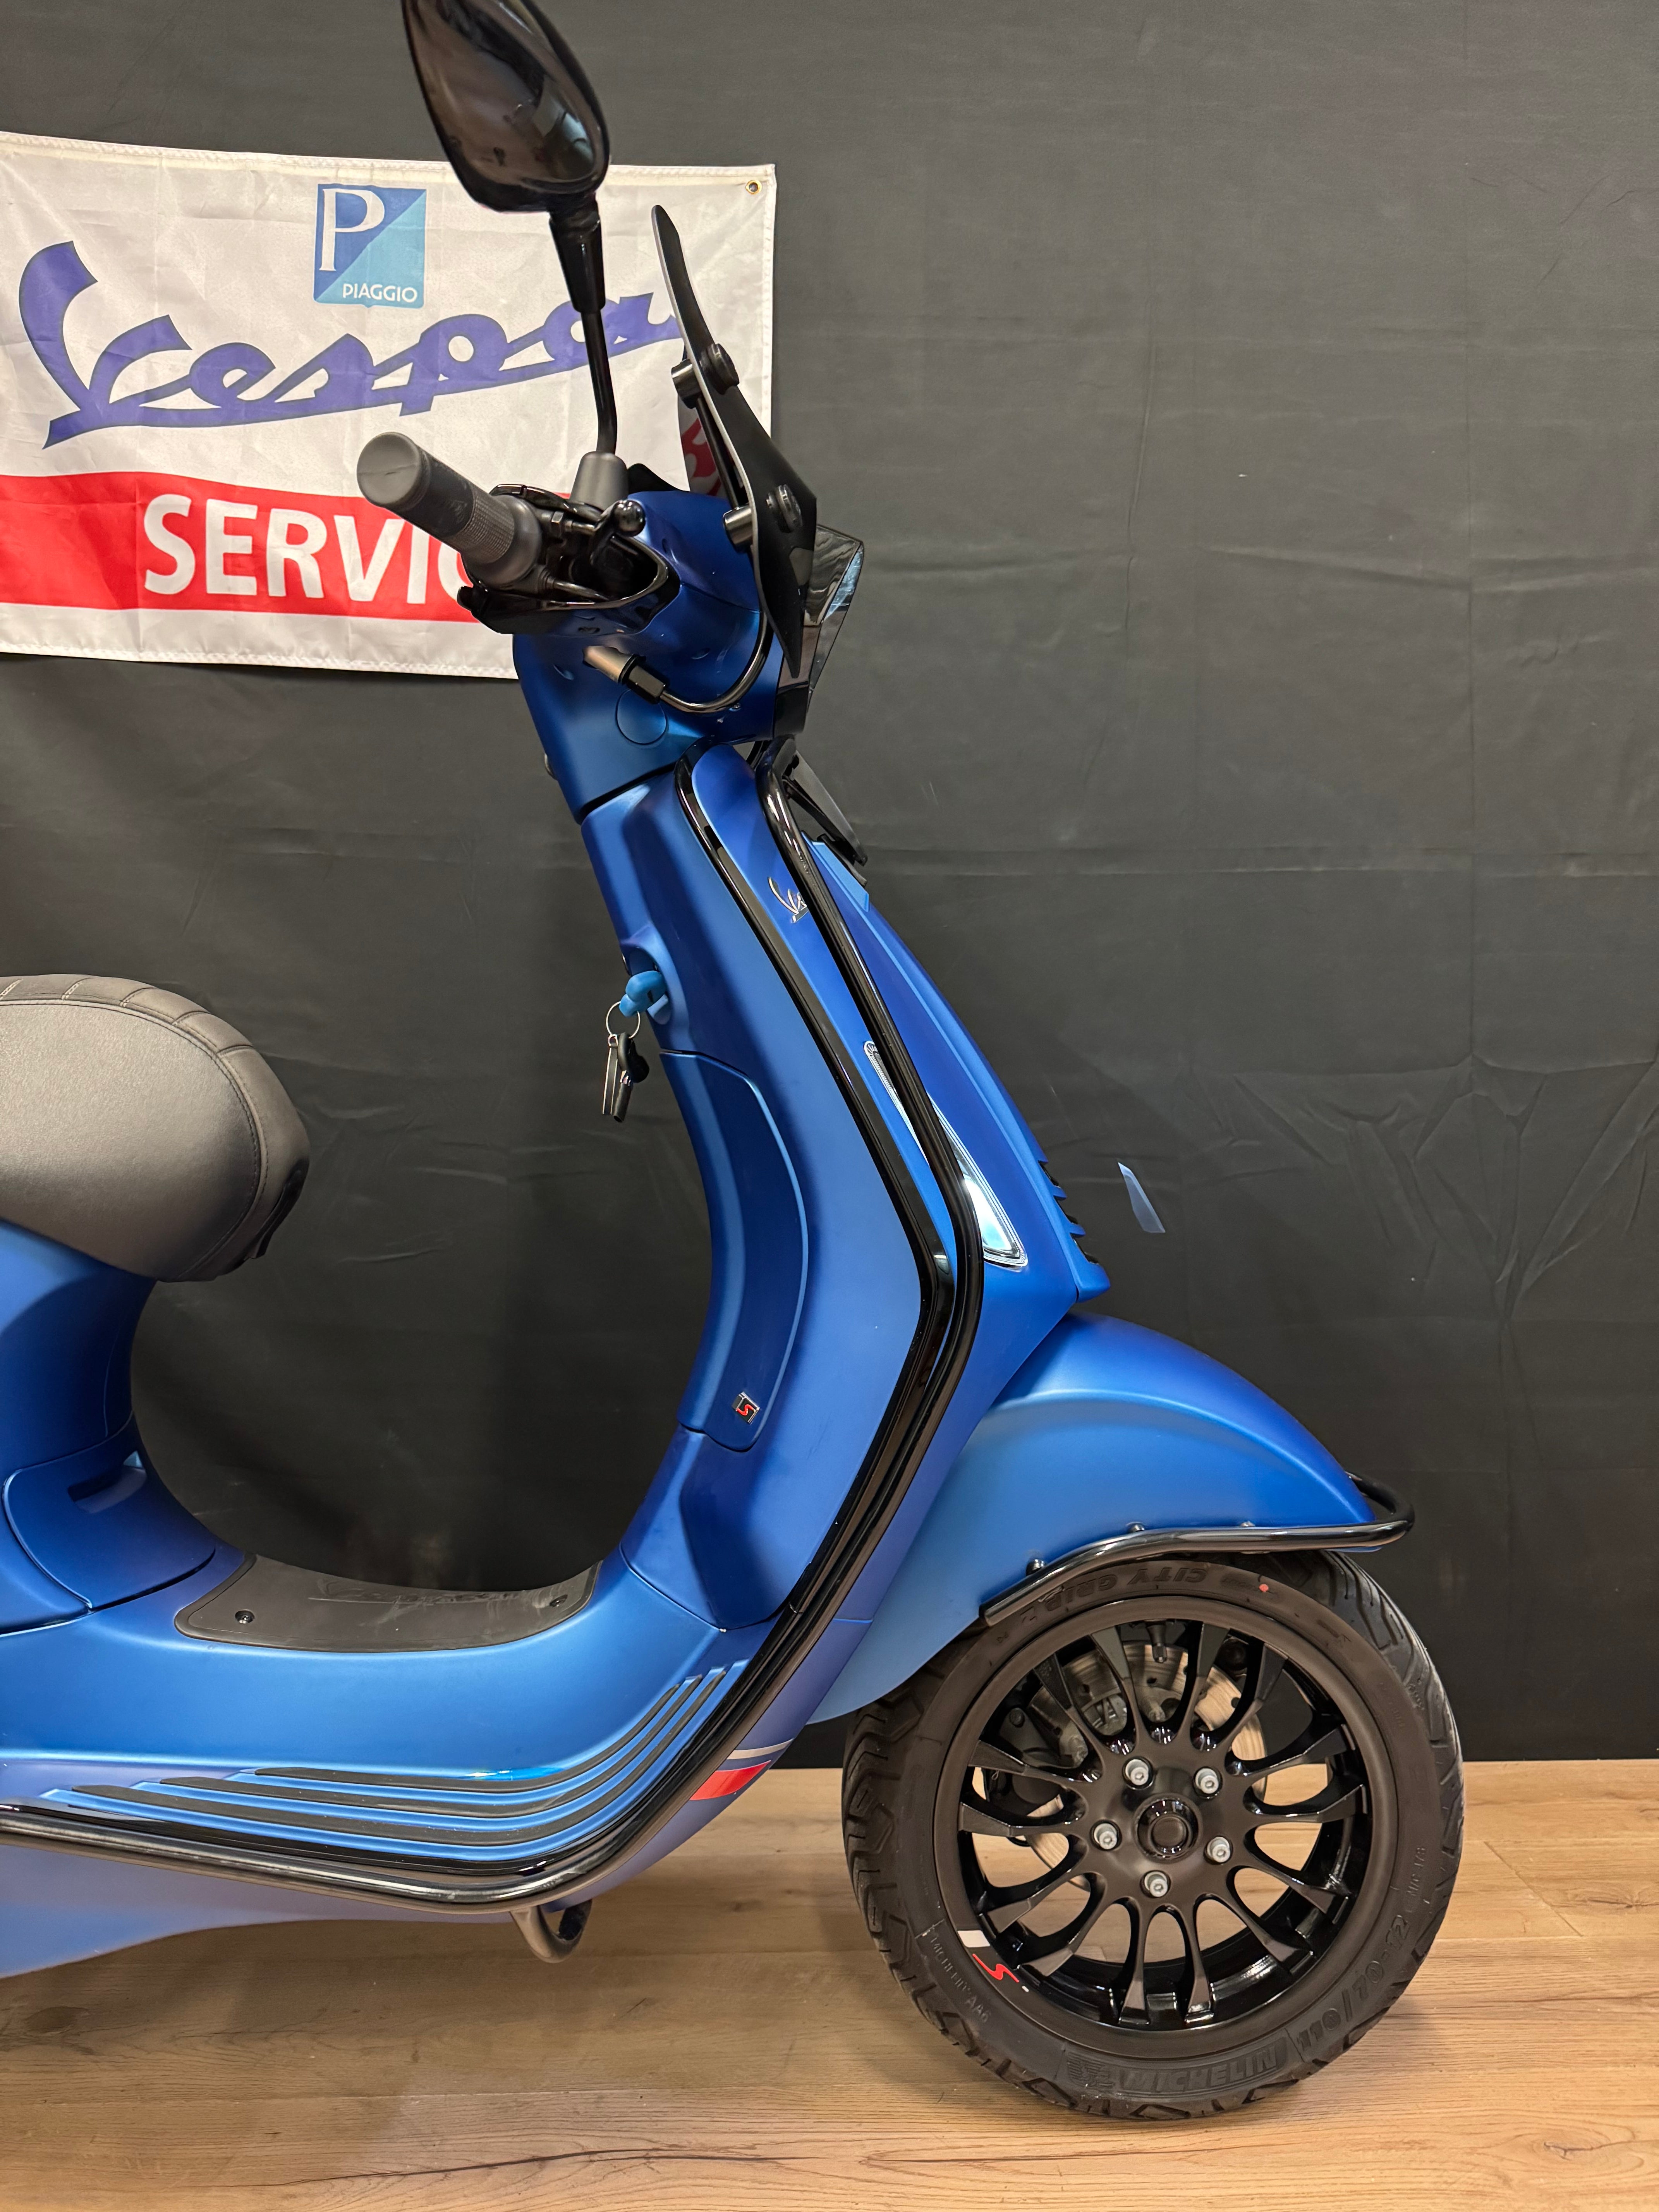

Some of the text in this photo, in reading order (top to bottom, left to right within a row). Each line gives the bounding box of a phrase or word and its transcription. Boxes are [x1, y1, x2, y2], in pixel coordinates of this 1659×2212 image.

[319, 188, 385, 271] P
[343, 283, 417, 303] PIAGGIO
[19, 241, 682, 449] Vespa
[1045, 1573, 1119, 1612] GRIP
[1127, 1566, 1208, 1586] CITY
[1121, 2044, 1277, 2092] MICHELIN
